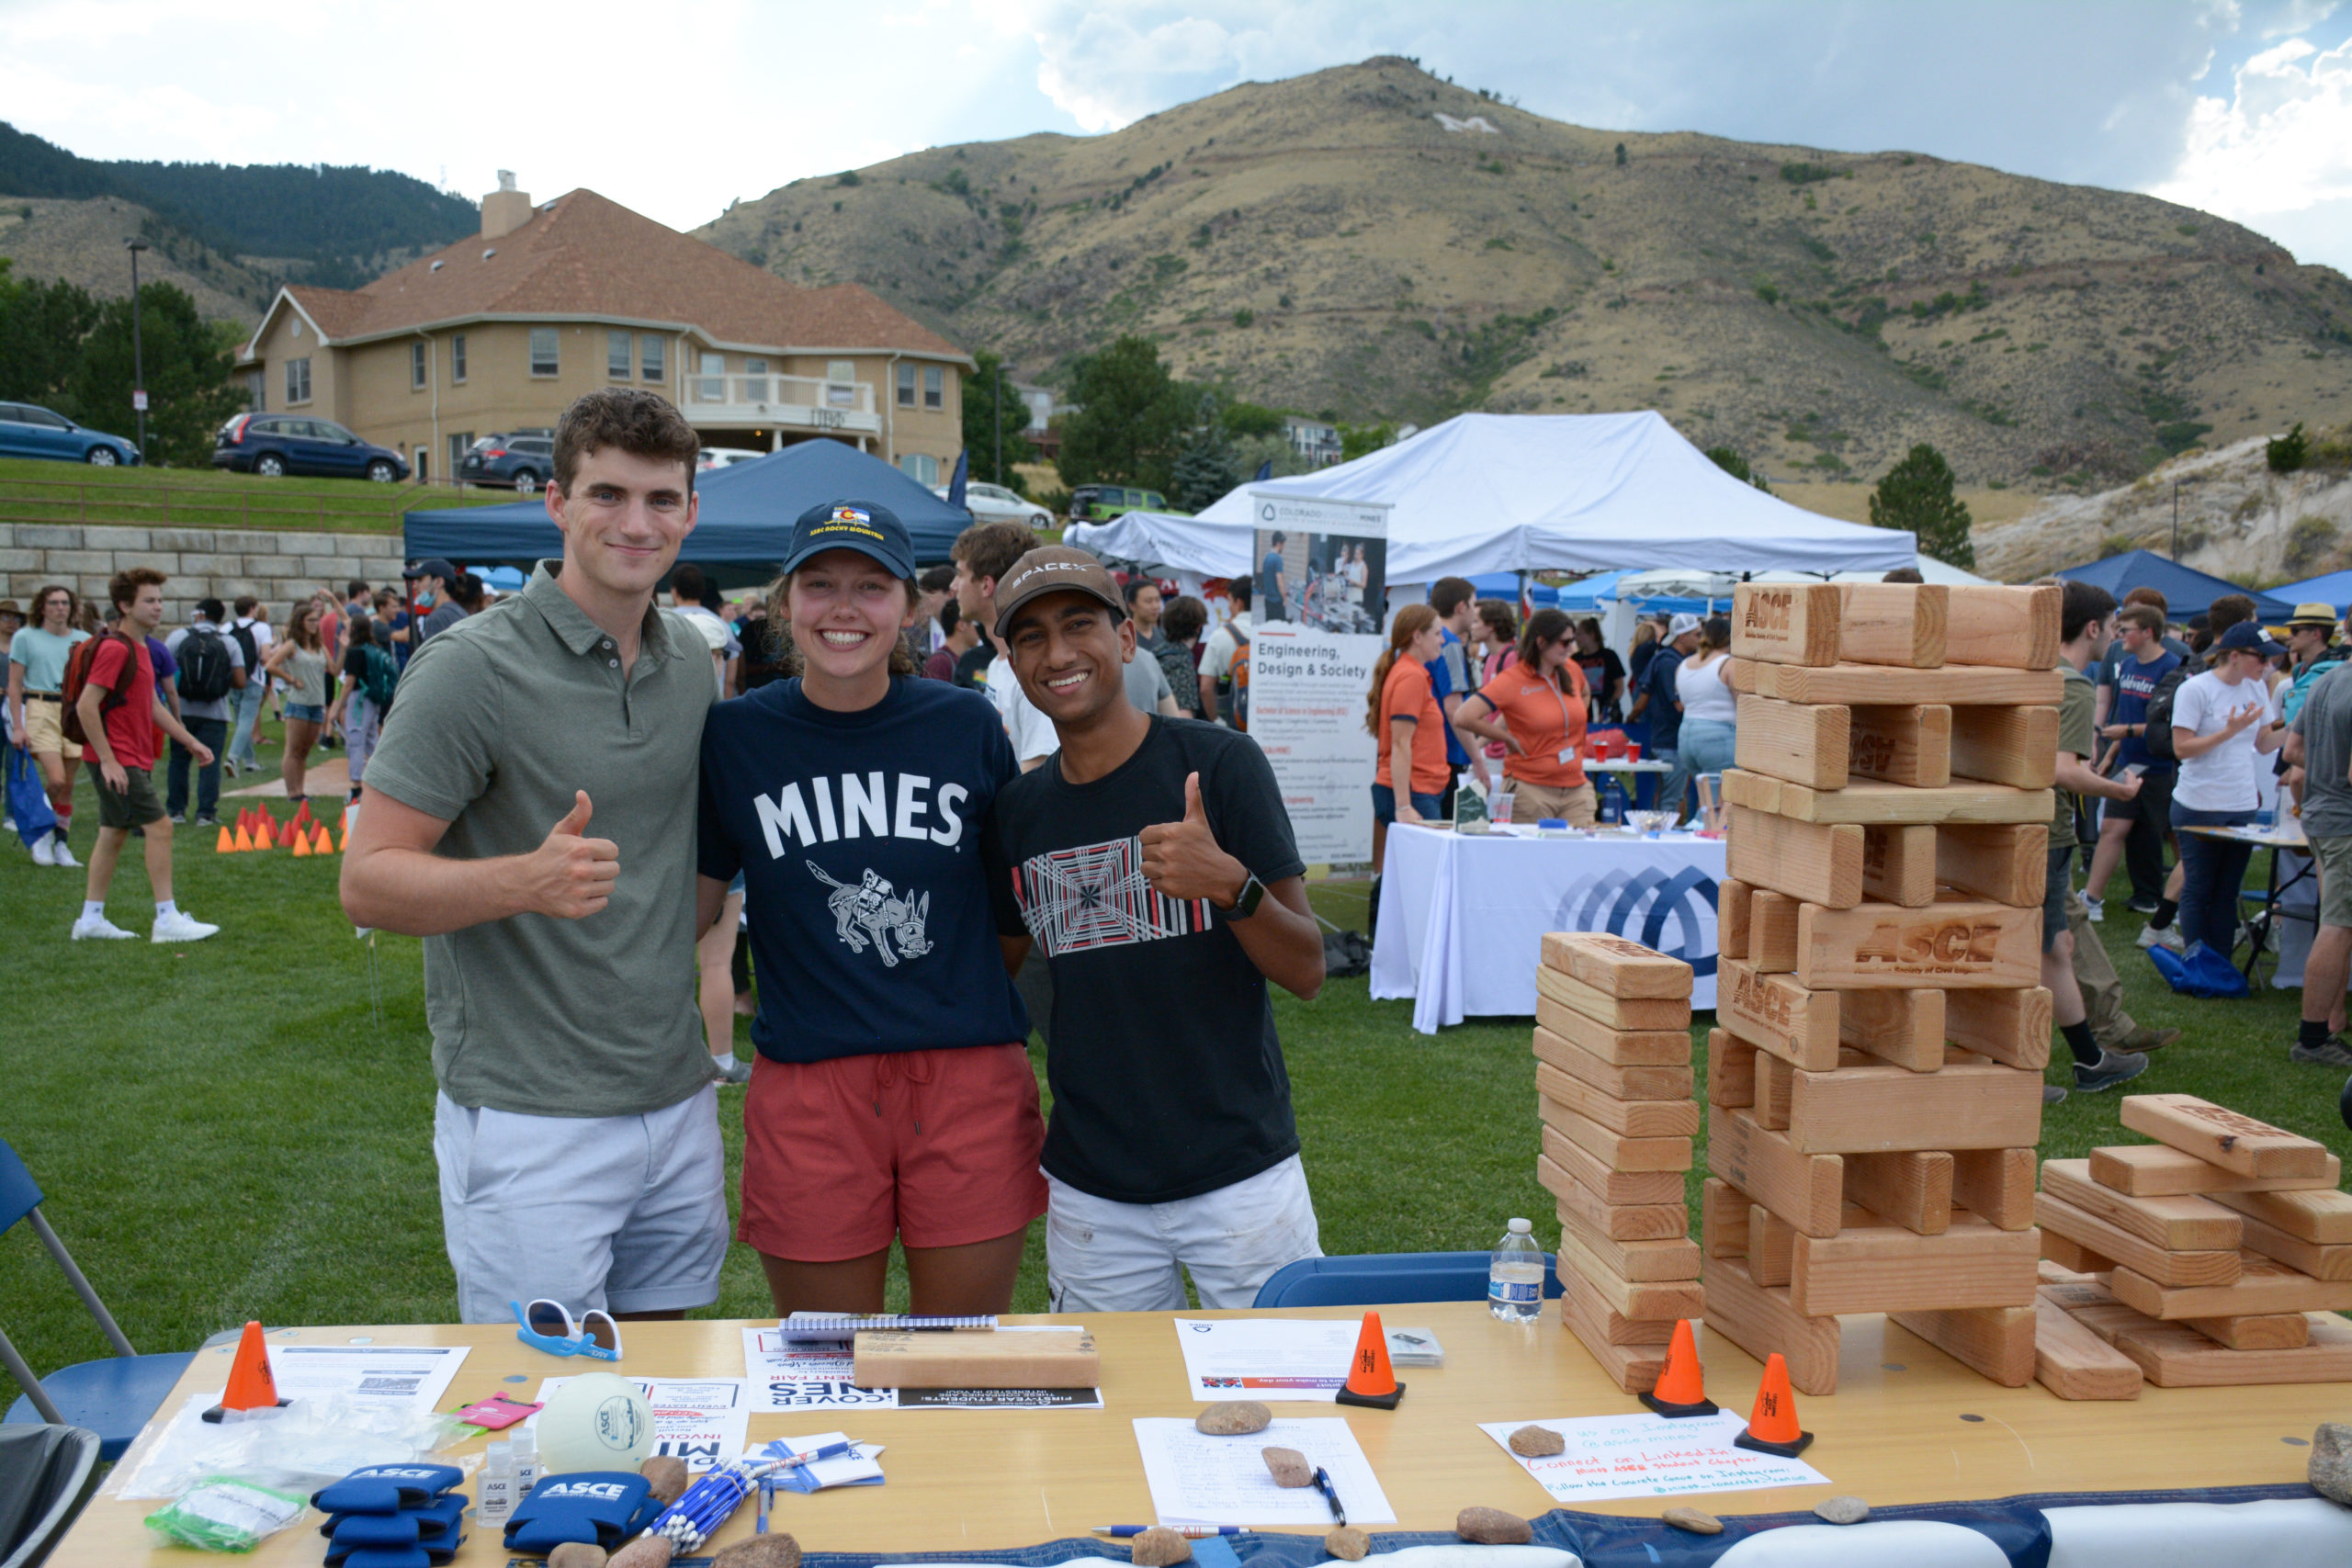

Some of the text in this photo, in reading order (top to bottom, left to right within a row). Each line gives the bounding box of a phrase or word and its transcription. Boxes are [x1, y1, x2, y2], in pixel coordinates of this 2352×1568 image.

[849, 526, 885, 541] MOUNTAIN
[1012, 562, 1093, 589] SPACEX
[1745, 593, 1792, 630] ASCE
[1258, 643, 1340, 660] Engineering,
[1258, 661, 1367, 679] Design & Society
[752, 771, 969, 860] MINES
[1855, 924, 2002, 964] ASCE
[1894, 966, 1923, 975] Society
[1935, 966, 1953, 975] Civil
[1734, 971, 1792, 1027] ASCE
[600, 1410, 610, 1435] ASCE
[1610, 1427, 1631, 1436] on
[1527, 1456, 1601, 1472] Connect
[1614, 1456, 1634, 1464] on
[1708, 1457, 1759, 1467] Chapter
[348, 1468, 441, 1480] ASCE
[1587, 1480, 1607, 1488] the
[1611, 1476, 1659, 1486] Concrete
[541, 1482, 628, 1497] ASCE
